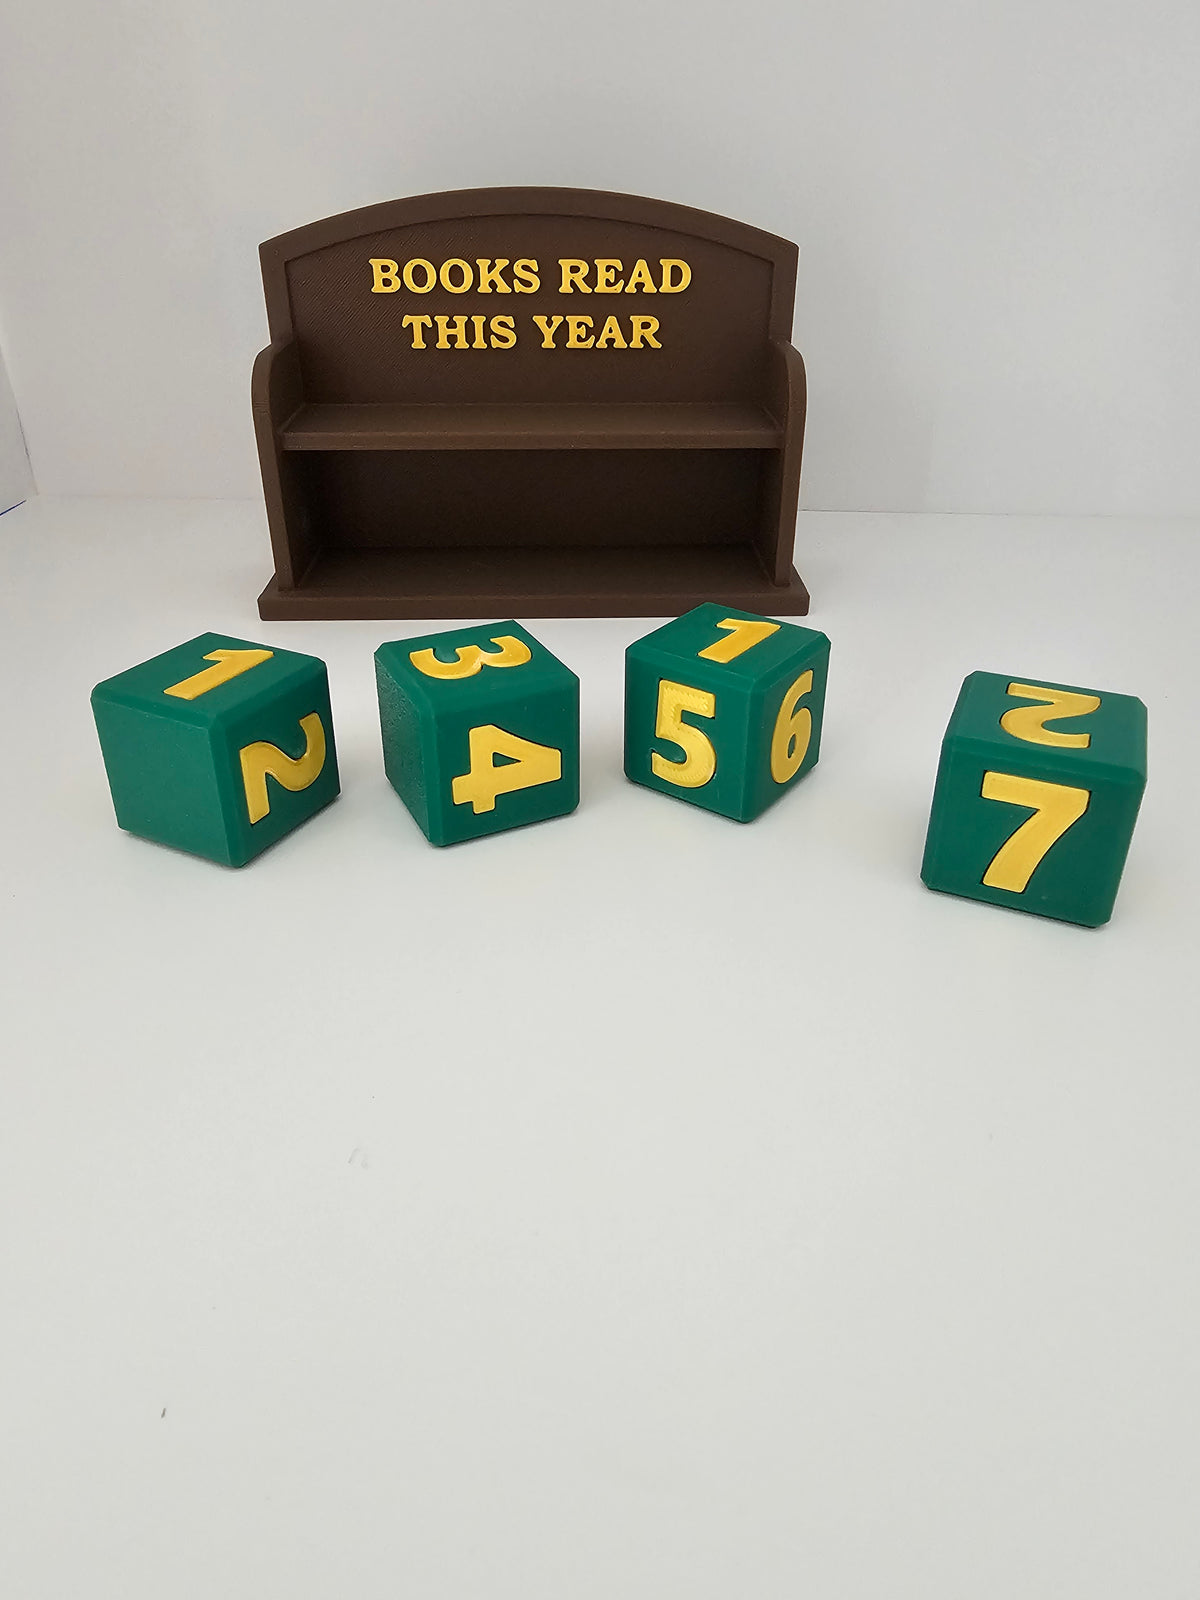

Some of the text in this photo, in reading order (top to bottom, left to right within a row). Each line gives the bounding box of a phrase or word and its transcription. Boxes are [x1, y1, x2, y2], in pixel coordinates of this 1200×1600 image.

[369, 257, 692, 295] BOOKS READ
[402, 314, 662, 350] THIS YEAR
[408, 635, 532, 680] 3
[699, 618, 781, 664] 1
[163, 648, 275, 701] 1
[651, 679, 717, 789] 5
[771, 669, 813, 784] 6
[1001, 683, 1102, 749] 2
[240, 712, 326, 824] 2
[451, 724, 562, 814] 4
[981, 771, 1090, 893] 7
